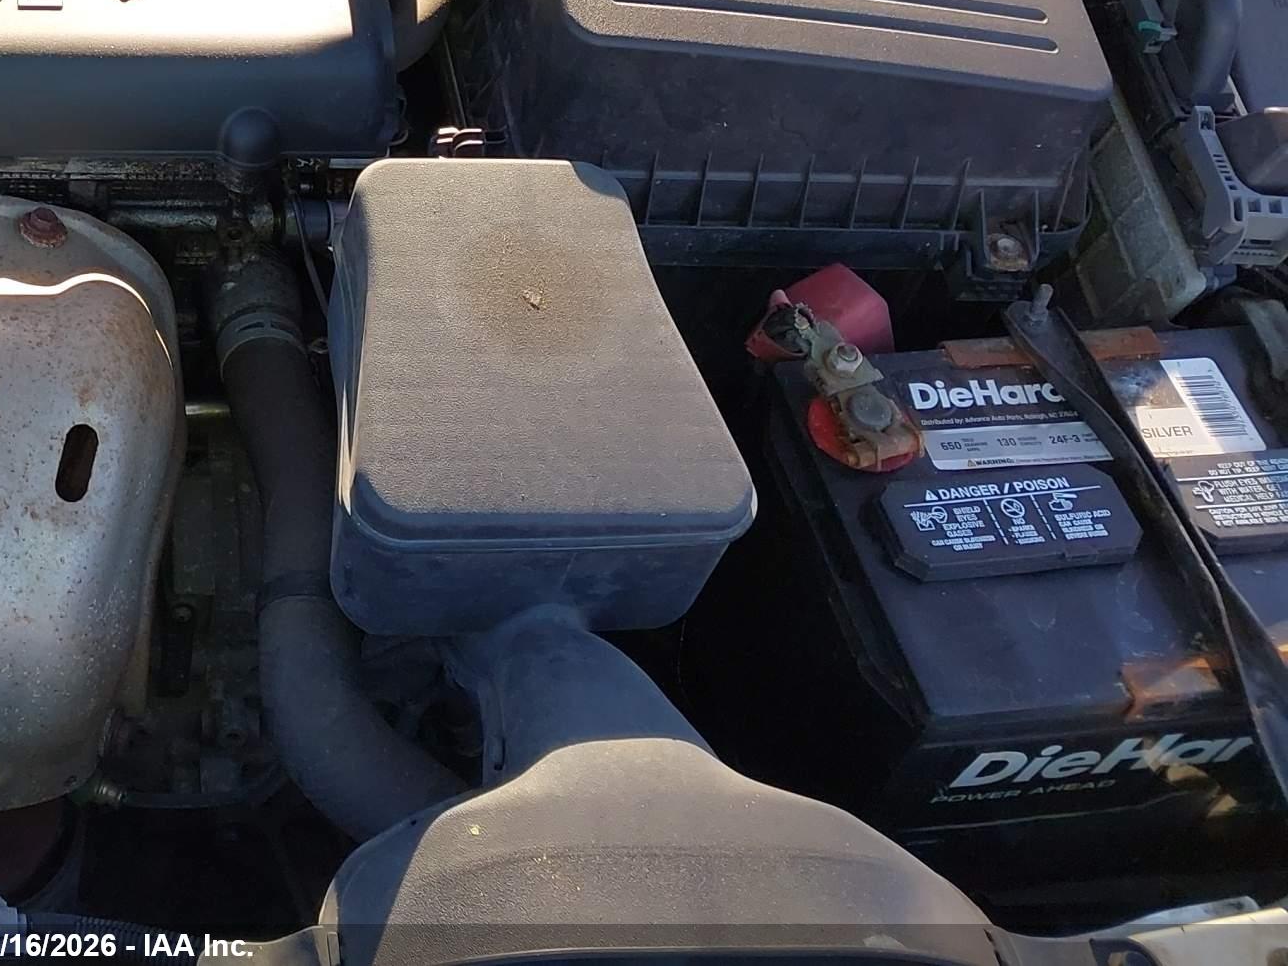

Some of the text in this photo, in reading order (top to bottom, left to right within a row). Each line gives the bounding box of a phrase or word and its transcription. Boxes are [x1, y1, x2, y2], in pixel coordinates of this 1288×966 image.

[1141, 425, 1193, 439] SILVER
[940, 441, 962, 451] 650
[996, 438, 1017, 447] 130
[938, 484, 1001, 501] DANGER
[1013, 477, 1071, 493] POISON
[1013, 517, 1026, 525] NO
[949, 734, 1253, 788] DieHar
[930, 780, 1115, 804] POWER AHEAD
